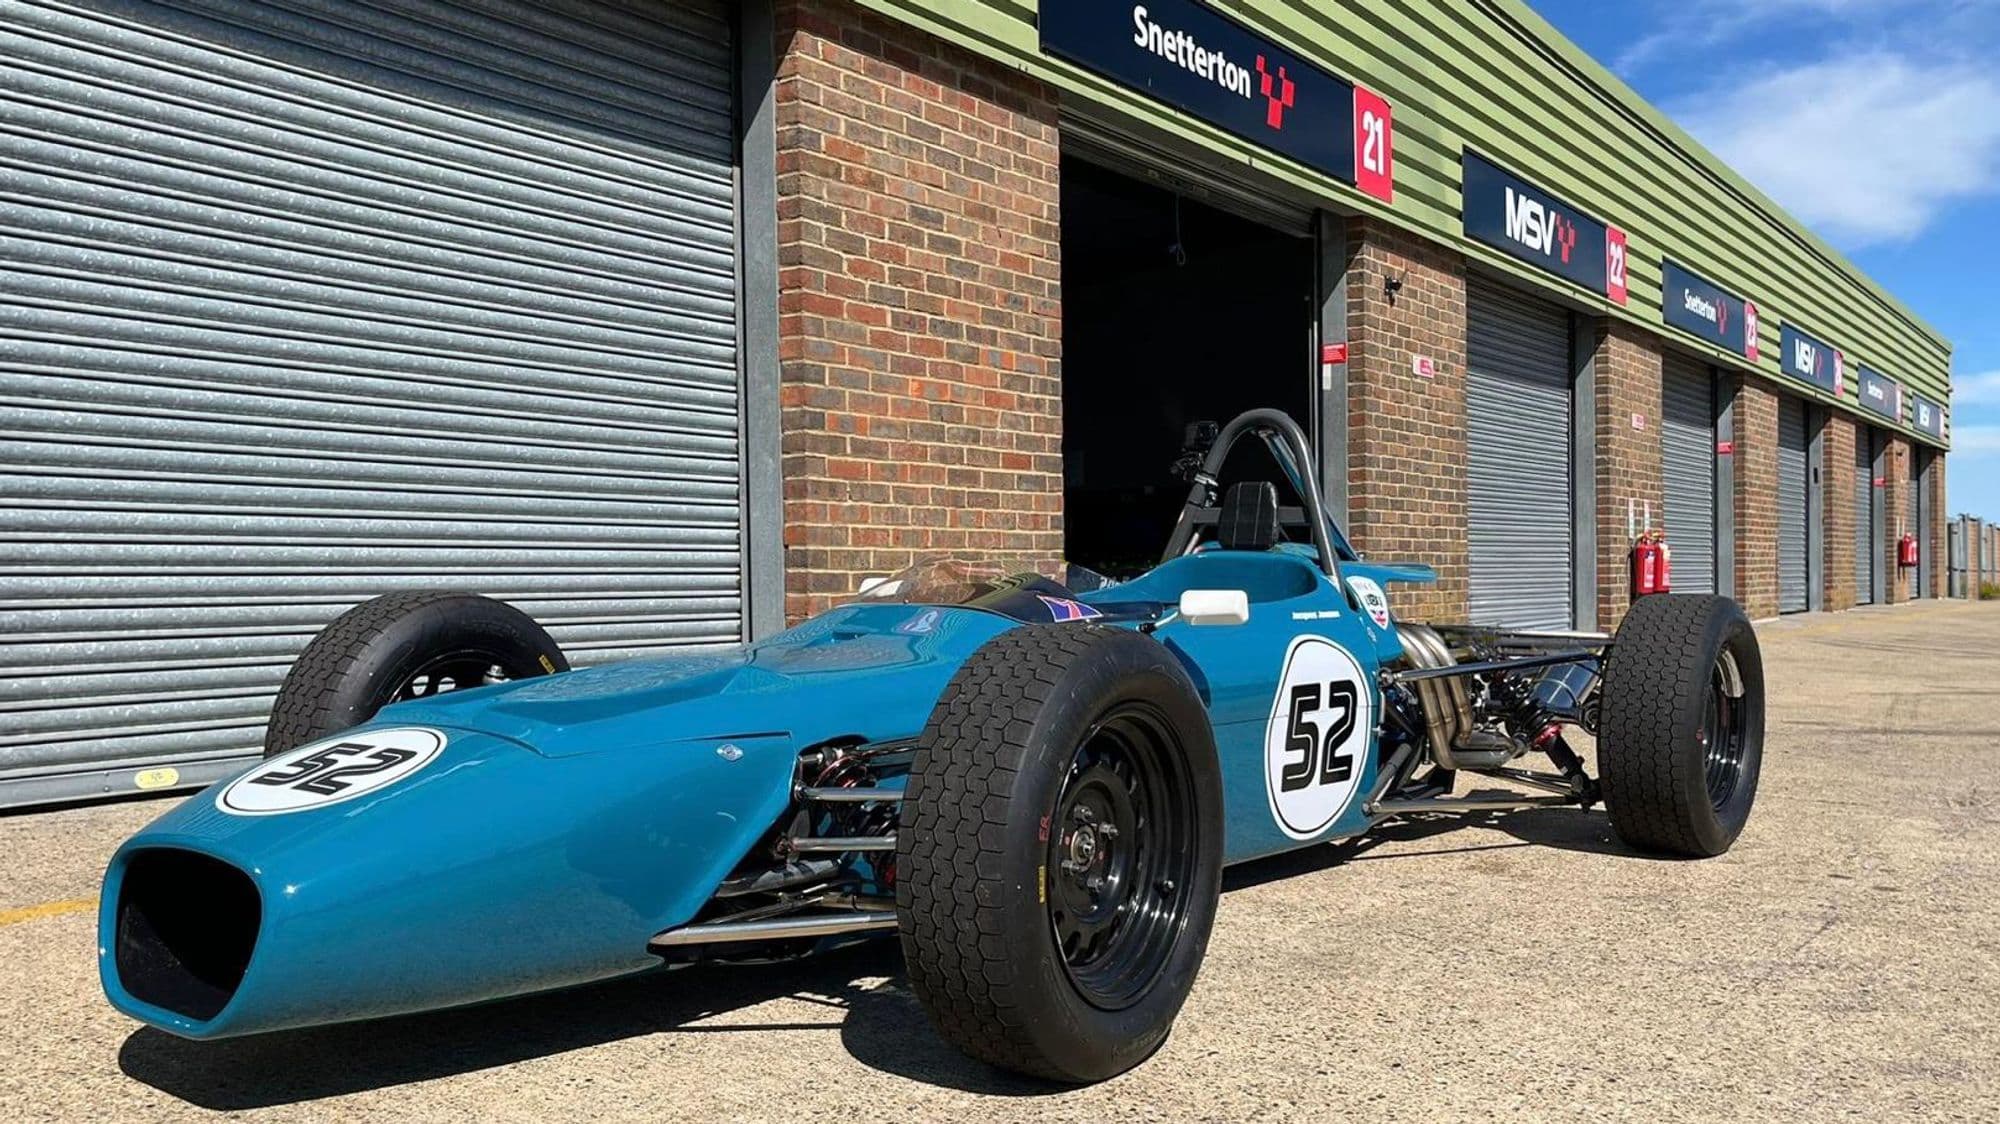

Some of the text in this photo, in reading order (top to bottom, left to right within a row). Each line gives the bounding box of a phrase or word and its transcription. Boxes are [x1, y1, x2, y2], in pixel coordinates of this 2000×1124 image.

[1134, 5, 1251, 99] Snetterton
[1363, 110, 1384, 176] 21
[1505, 186, 1556, 256] MSV
[1609, 241, 1624, 288] 22
[1684, 288, 1717, 323] Snetterton
[1795, 338, 1815, 376] MSV
[1281, 679, 1357, 792] 52
[248, 743, 418, 796] 52
